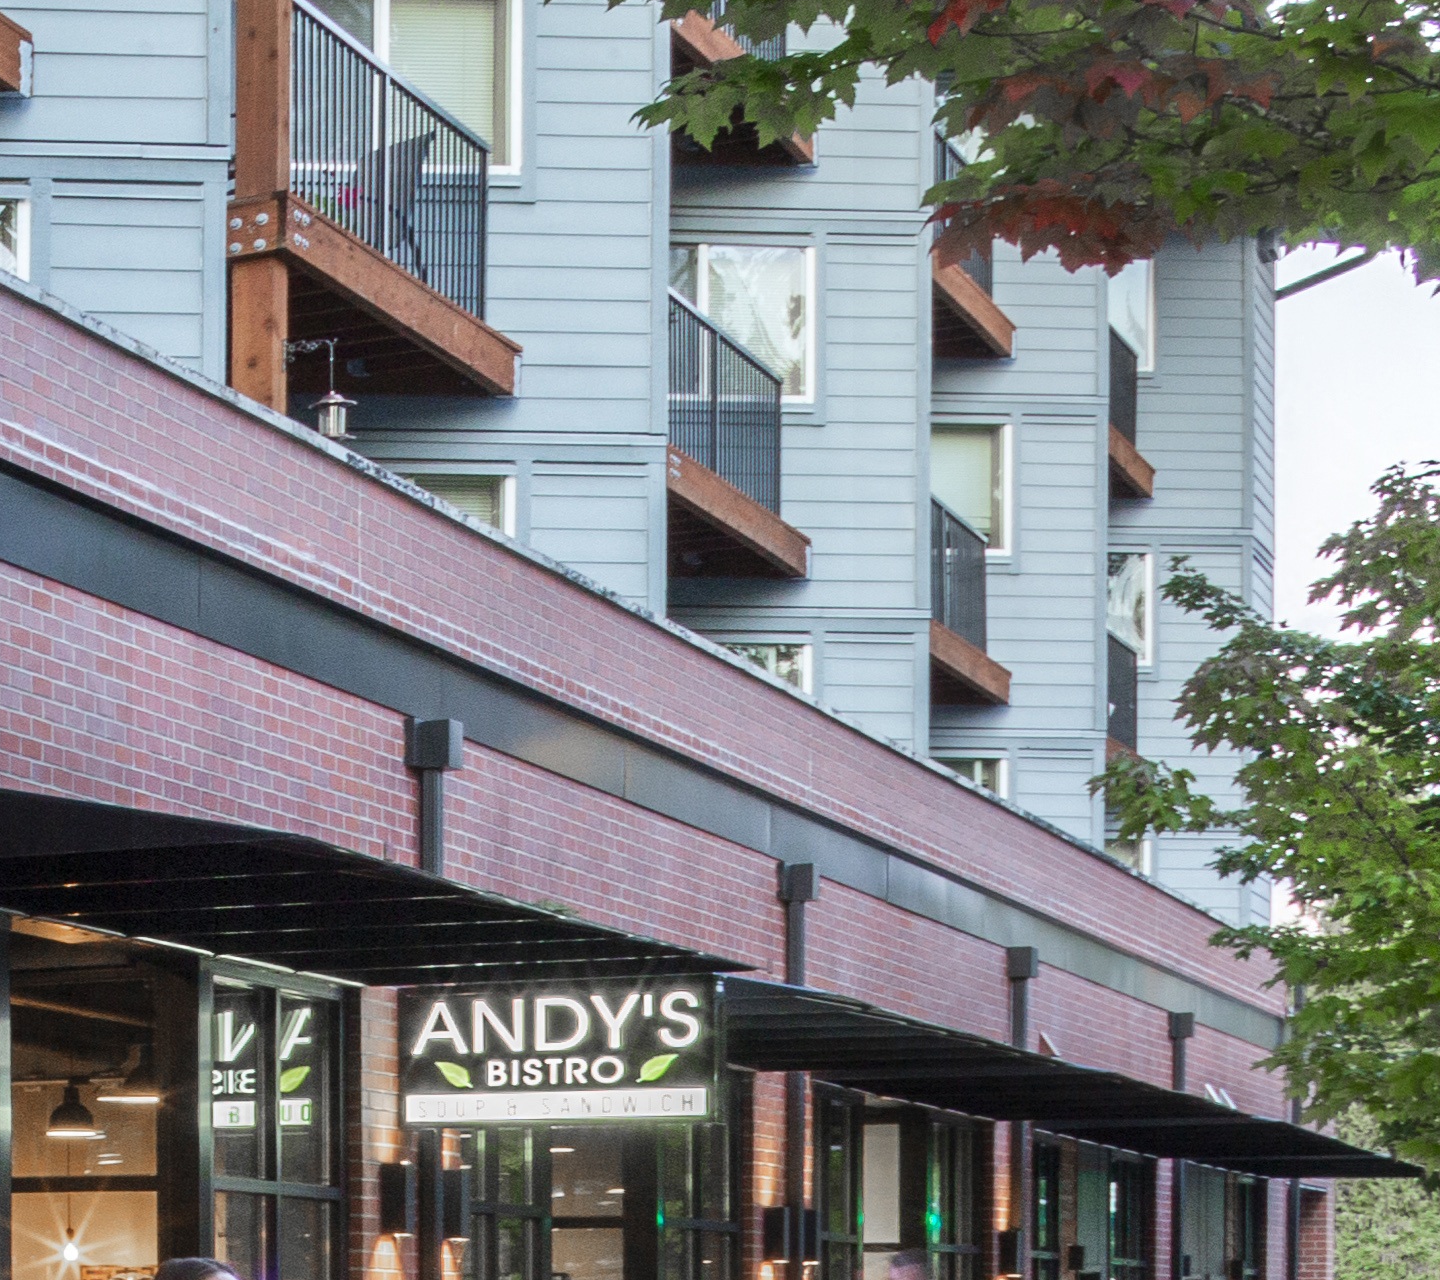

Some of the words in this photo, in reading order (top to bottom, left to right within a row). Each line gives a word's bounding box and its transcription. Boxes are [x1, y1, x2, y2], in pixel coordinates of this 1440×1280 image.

[411, 990, 700, 1055] ANDY'S
[486, 1055, 625, 1087] BISTRO
[417, 1099, 486, 1119] SOUP
[541, 1093, 694, 1116] SANDWICH
